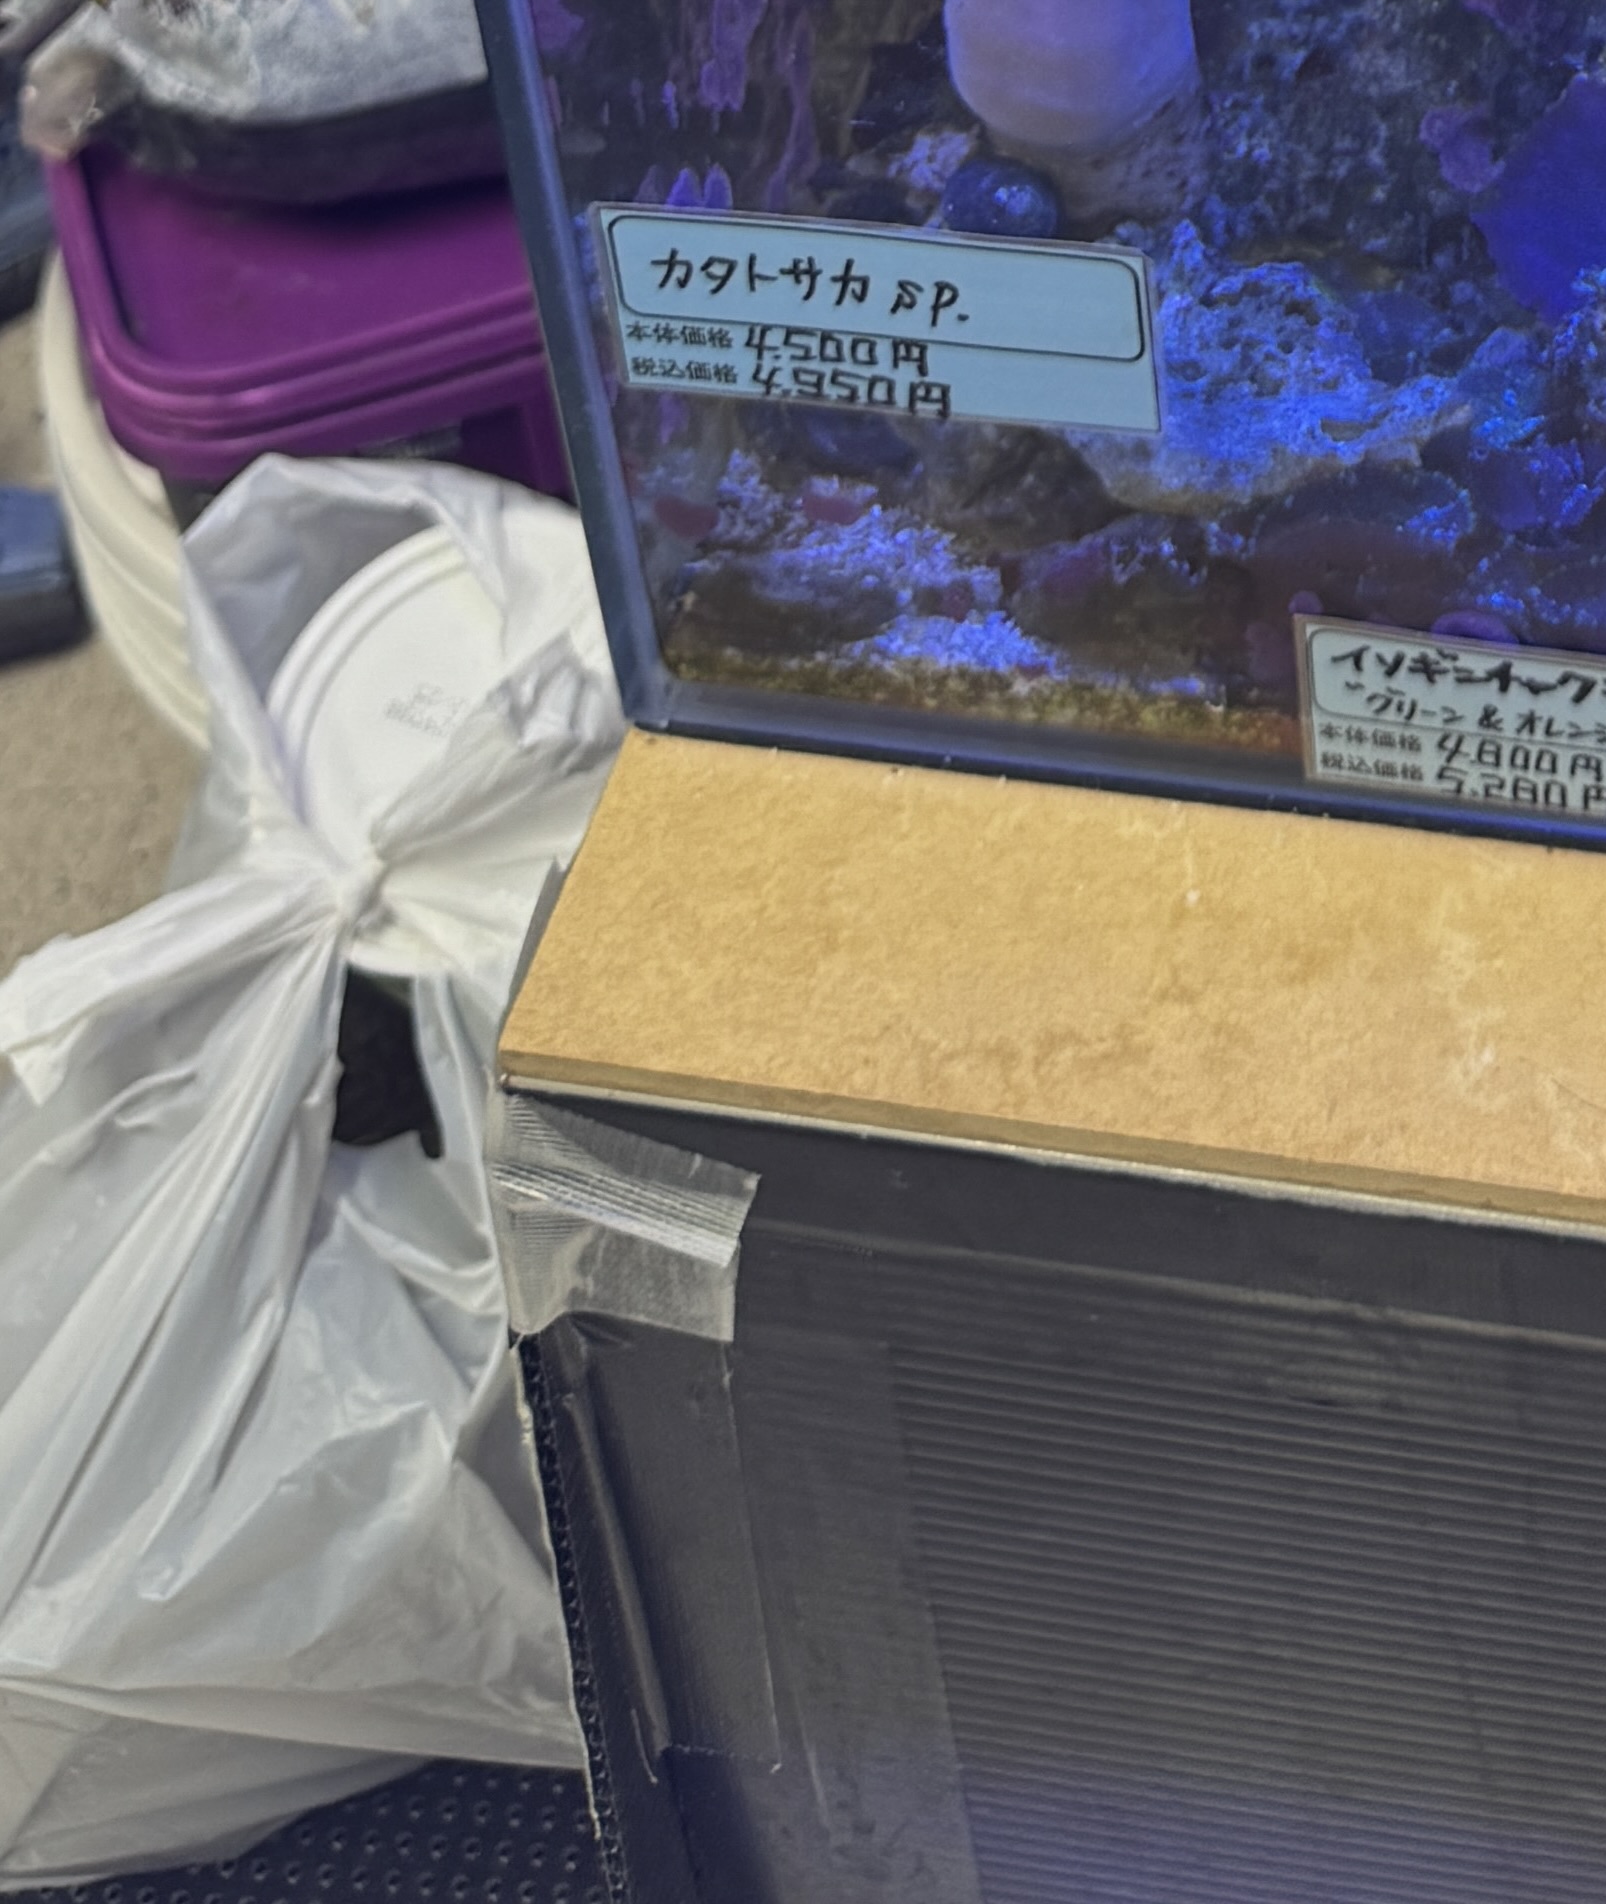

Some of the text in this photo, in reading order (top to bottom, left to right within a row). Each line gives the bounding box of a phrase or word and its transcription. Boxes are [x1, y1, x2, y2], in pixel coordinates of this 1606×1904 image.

[651, 248, 870, 306] カタトサカ
[626, 321, 734, 349] 本体価格
[631, 356, 738, 384] 税込価格
[1478, 703, 1503, 732] &
[1320, 722, 1422, 752] 本体価格
[1320, 751, 1423, 782] 税込価格
